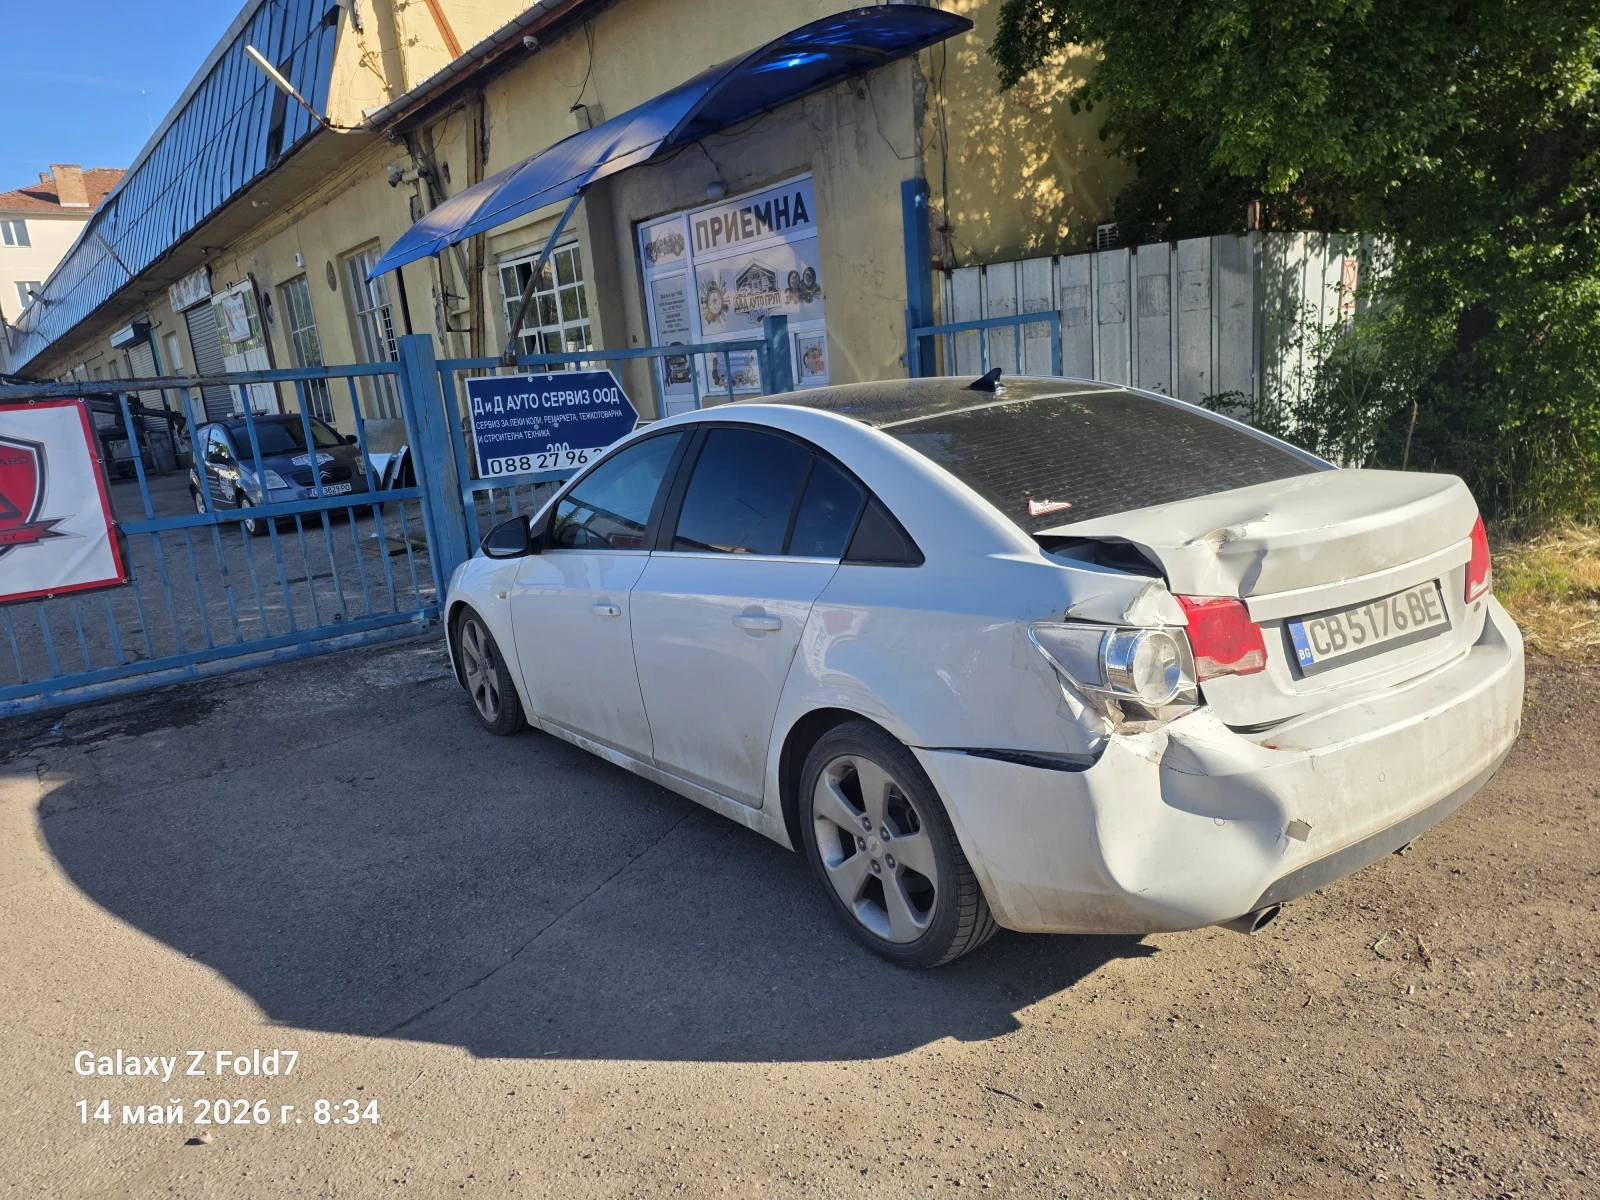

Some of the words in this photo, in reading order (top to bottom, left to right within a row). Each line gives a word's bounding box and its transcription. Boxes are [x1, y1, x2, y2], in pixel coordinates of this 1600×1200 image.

[695, 191, 809, 251] ПРИЕМНА
[750, 294, 764, 309] АУТО
[765, 292, 781, 306] ГРУП
[506, 393, 539, 411] АУТО
[542, 389, 591, 407] СЕРВИЗ
[592, 387, 620, 405] ООД
[476, 420, 501, 430] СЕРВИЗ
[501, 419, 510, 428] ЗА
[510, 417, 526, 427] ЛЕКИ
[526, 416, 543, 426] КОЛИ,
[543, 413, 579, 424] РЕМАРКЕТА,
[579, 409, 623, 421] ТЕЖКОТОВАРНА
[478, 435, 484, 444] И
[484, 431, 524, 443] СТРОИТЕЛНА
[524, 429, 551, 439] ТЕХНИКА
[490, 456, 532, 475] 088
[536, 452, 559, 469] 27
[565, 450, 588, 465] 96
[1298, 647, 1312, 661] BG
